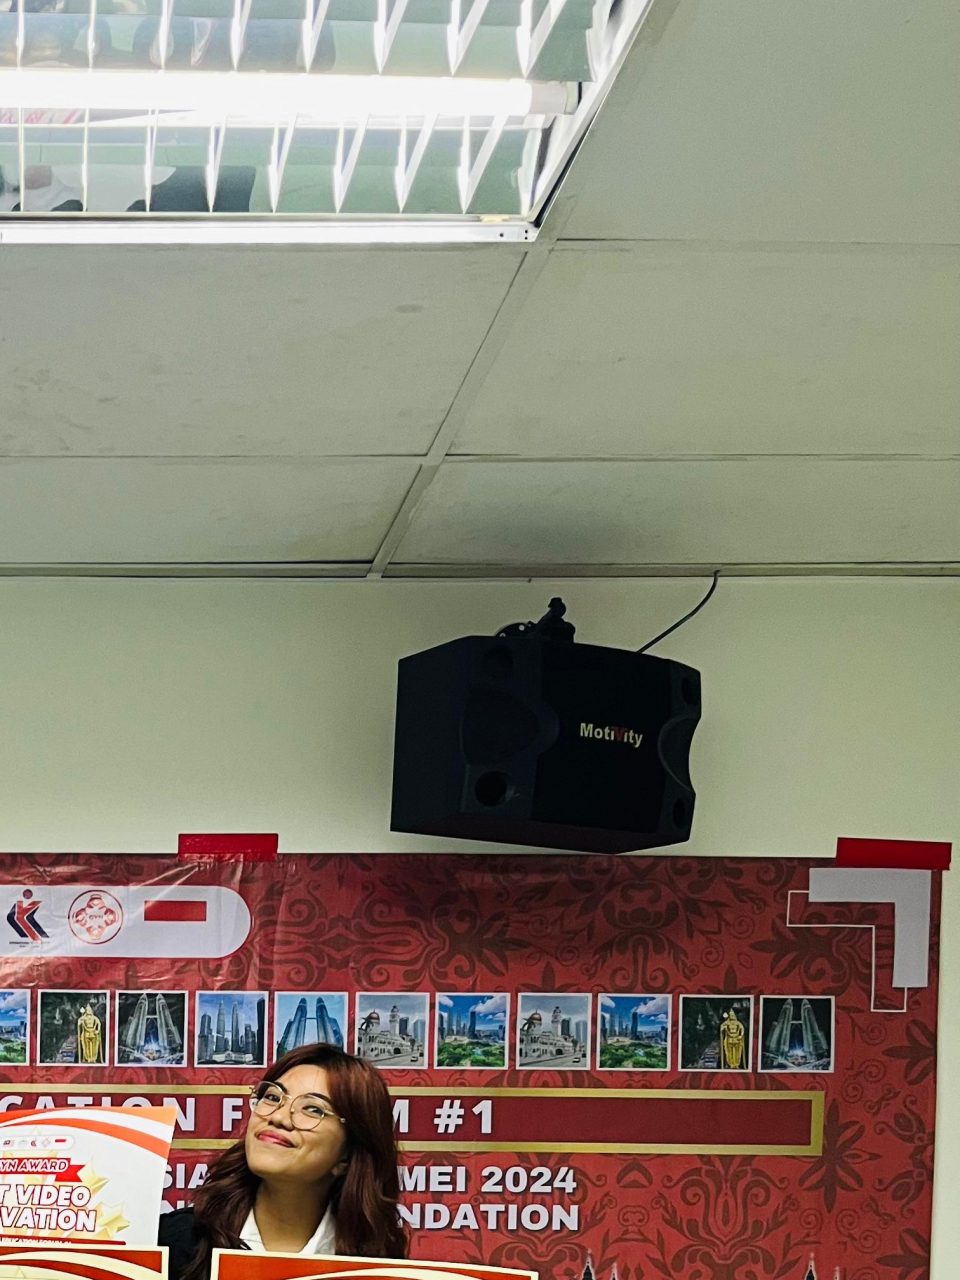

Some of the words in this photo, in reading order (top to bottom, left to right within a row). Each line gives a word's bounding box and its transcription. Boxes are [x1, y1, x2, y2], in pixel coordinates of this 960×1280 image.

[433, 1099, 493, 1134] #1
[18, 1160, 69, 1173] AWARD
[397, 1166, 466, 1192] MEI
[481, 1166, 577, 1193] 2024
[16, 1184, 91, 1207] VIDEO
[396, 1203, 579, 1231] NDATION
